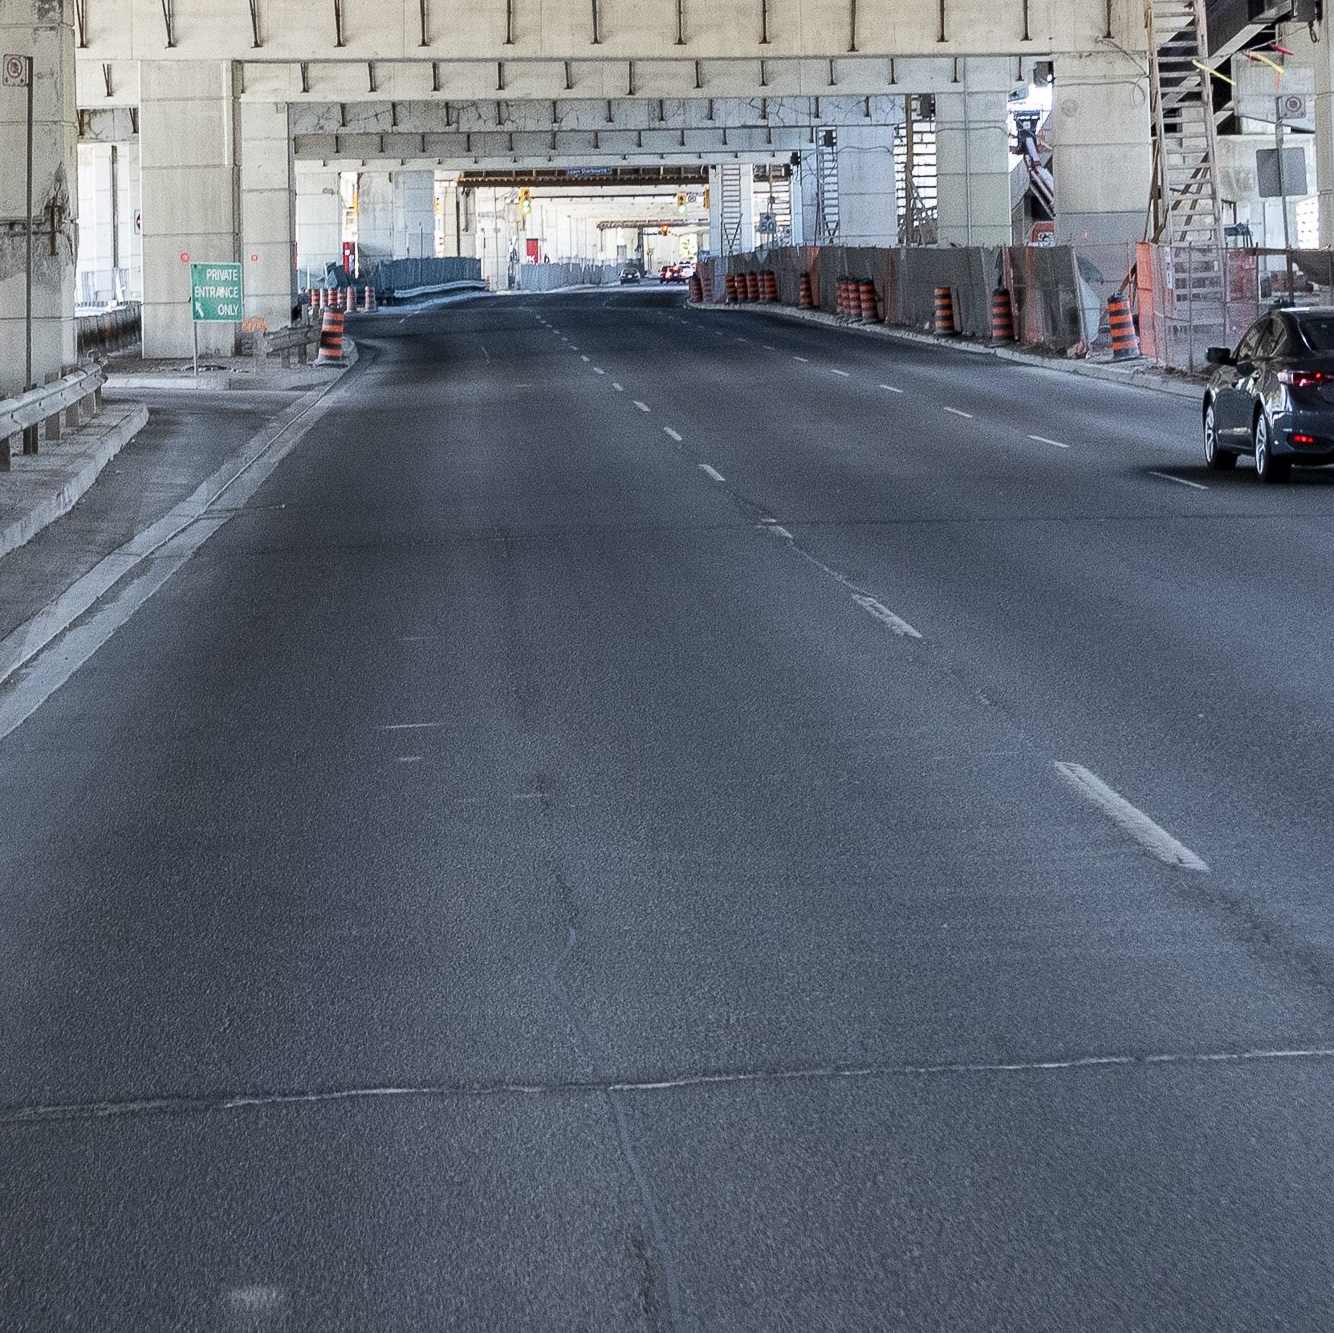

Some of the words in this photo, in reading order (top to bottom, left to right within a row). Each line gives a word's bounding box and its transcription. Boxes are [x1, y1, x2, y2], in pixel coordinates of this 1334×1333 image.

[761, 222, 775, 232] 50
[206, 268, 238, 281] PRIVATE
[194, 286, 239, 299] ENTRANCE
[217, 304, 238, 316] ONLY
